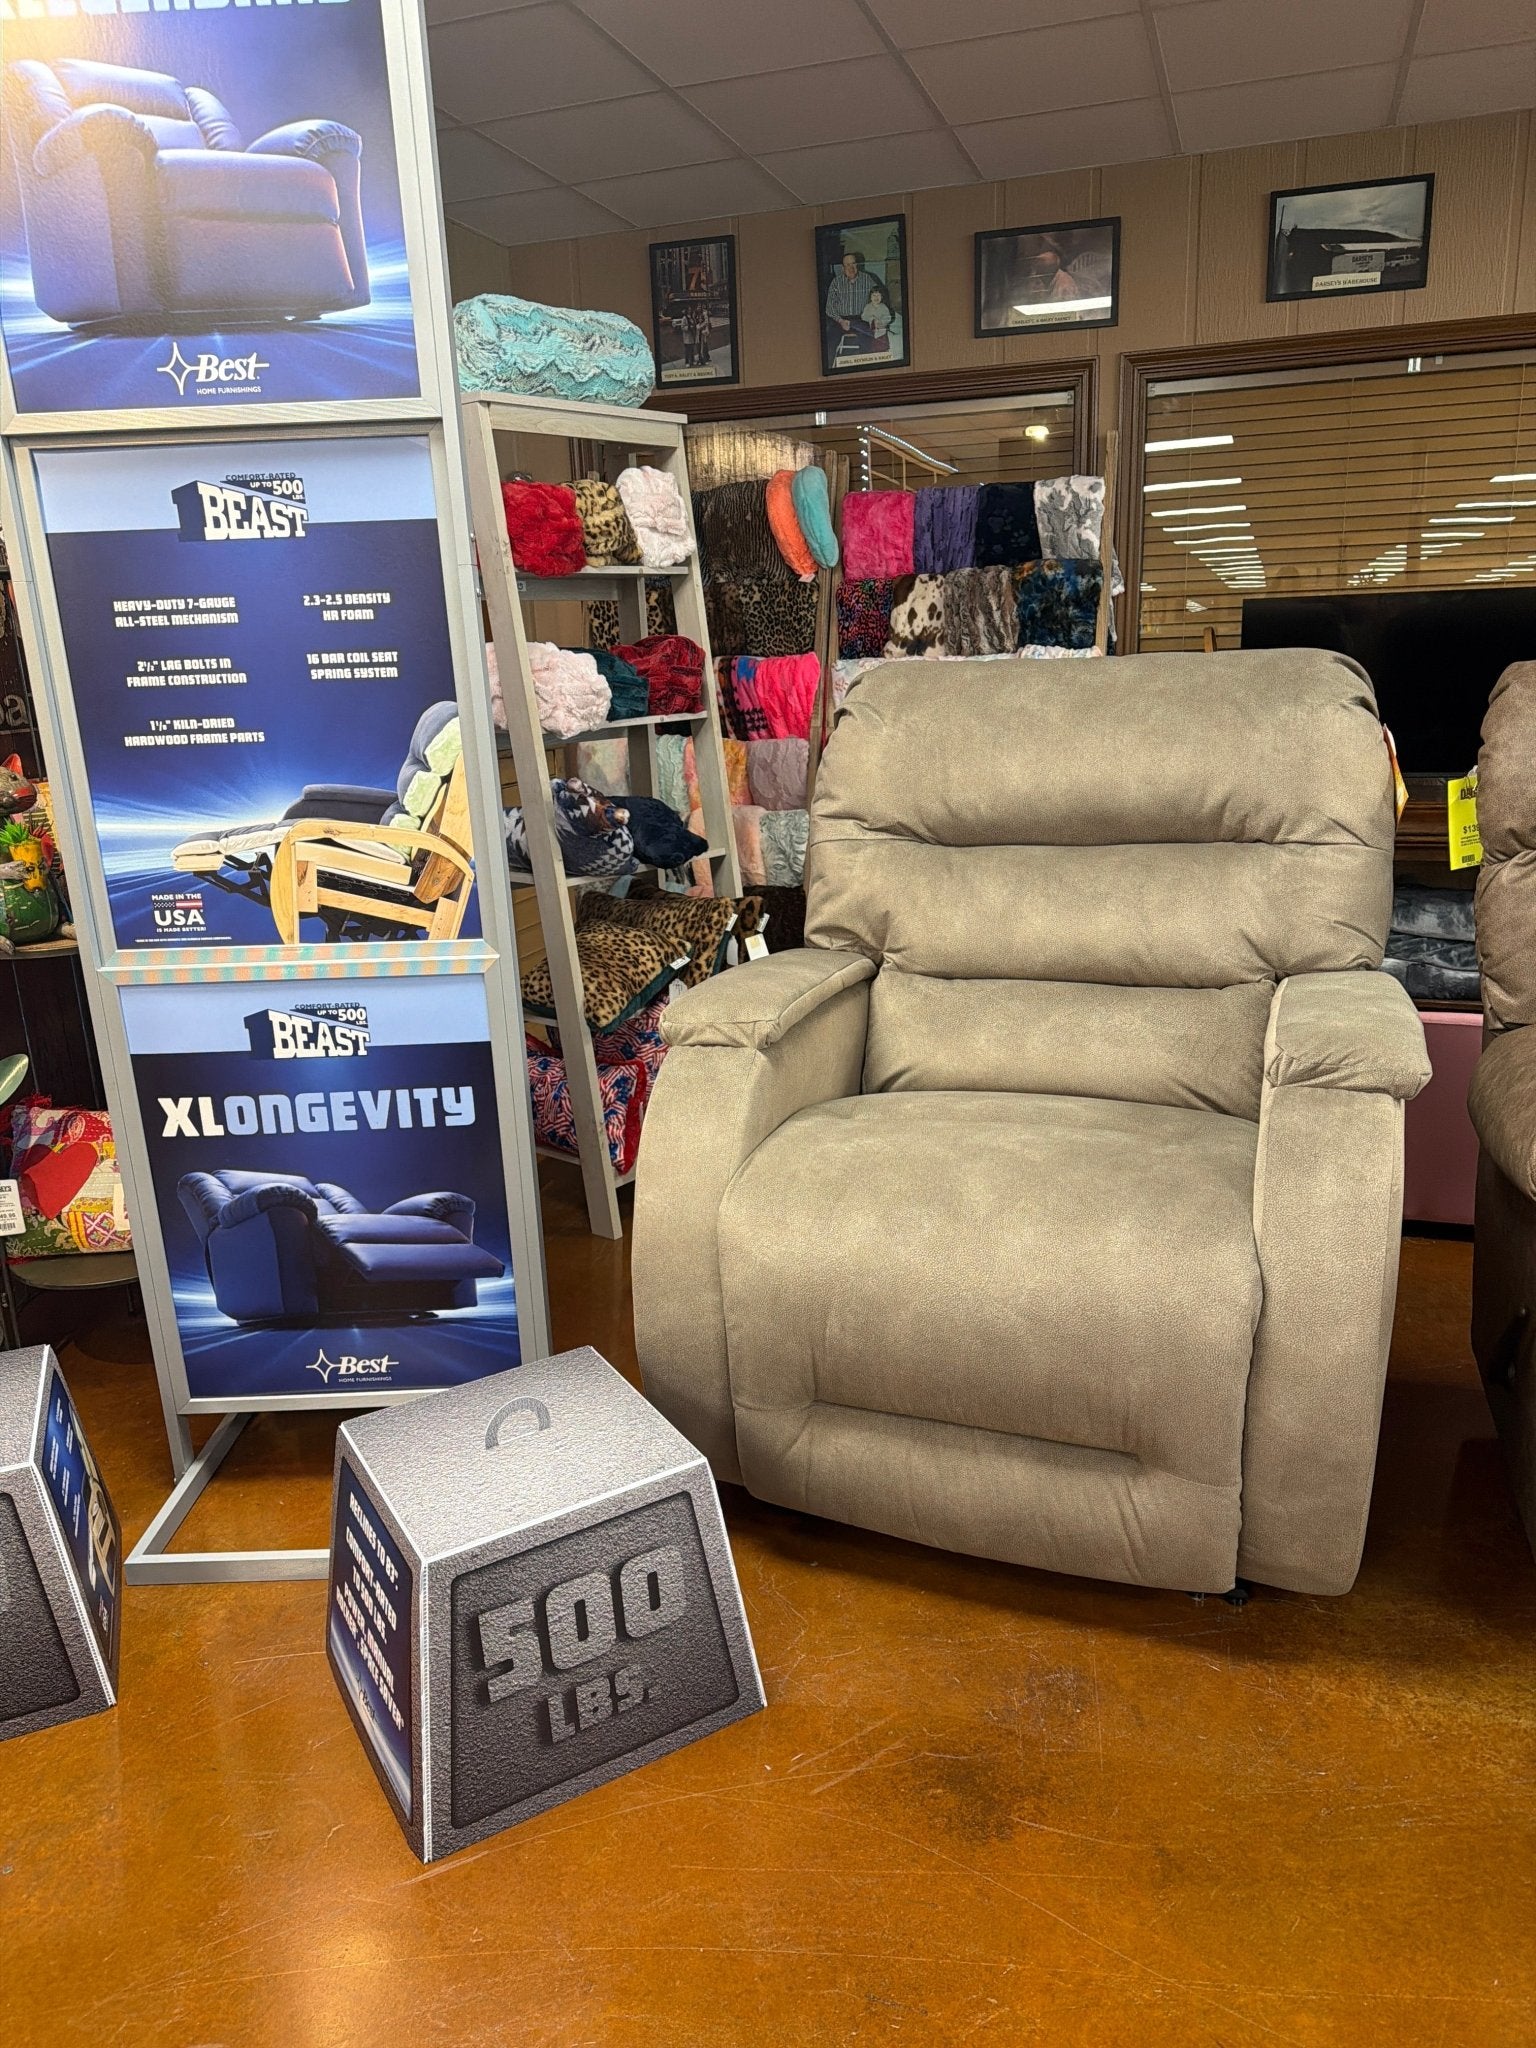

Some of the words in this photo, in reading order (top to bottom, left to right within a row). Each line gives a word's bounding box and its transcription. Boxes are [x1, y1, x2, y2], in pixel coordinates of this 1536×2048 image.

[196, 352, 269, 382] Best
[197, 387, 216, 395] HOME
[218, 386, 261, 394] FURNISHINGS
[226, 472, 296, 481] COMFORT-RATED
[272, 480, 304, 495] 500
[197, 481, 308, 541] BEAST
[113, 599, 185, 612] HEAVY-DUTY
[187, 597, 236, 609] 7-GAUGE
[303, 593, 343, 606] 2.3-2.5
[344, 592, 391, 605] DENSITY
[115, 615, 170, 627] ALL-STEEL
[171, 612, 239, 625] MECHANISM
[322, 610, 339, 621] HR
[340, 609, 374, 620] FOAM
[161, 660, 182, 670] LAG
[184, 658, 217, 670] BOLTS
[219, 658, 232, 668] IN
[306, 653, 320, 665] 16
[321, 652, 345, 664] BAR
[346, 652, 370, 663] COIL
[371, 651, 398, 663] SEAT
[126, 675, 167, 688] FRAME
[167, 673, 247, 686] CONSTRUCTION
[310, 668, 352, 680] SPRING
[353, 666, 398, 678] SYSTEM
[172, 718, 235, 730] KILN-DRIED
[124, 734, 189, 747] HARDWOOD
[189, 733, 229, 744] FRAME
[229, 732, 265, 743] PARTS
[294, 1002, 360, 1010] COMFORT-RATED
[337, 1008, 367, 1021] 500
[268, 1010, 371, 1059] BEAST
[157, 1086, 475, 1137] XLONGEVITY
[338, 1355, 399, 1374] Best
[350, 1491, 377, 1550] RECLINES
[376, 1538, 386, 1566] TO
[346, 1526, 397, 1631] COMFORT-RATED
[353, 1565, 361, 1592] TO
[361, 1580, 374, 1616] 500
[373, 1605, 387, 1644] LBS.
[478, 1546, 687, 1703] 500
[344, 1581, 366, 1640] POWER,
[367, 1627, 394, 1693] MANUAL
[360, 1636, 379, 1686] SPACE
